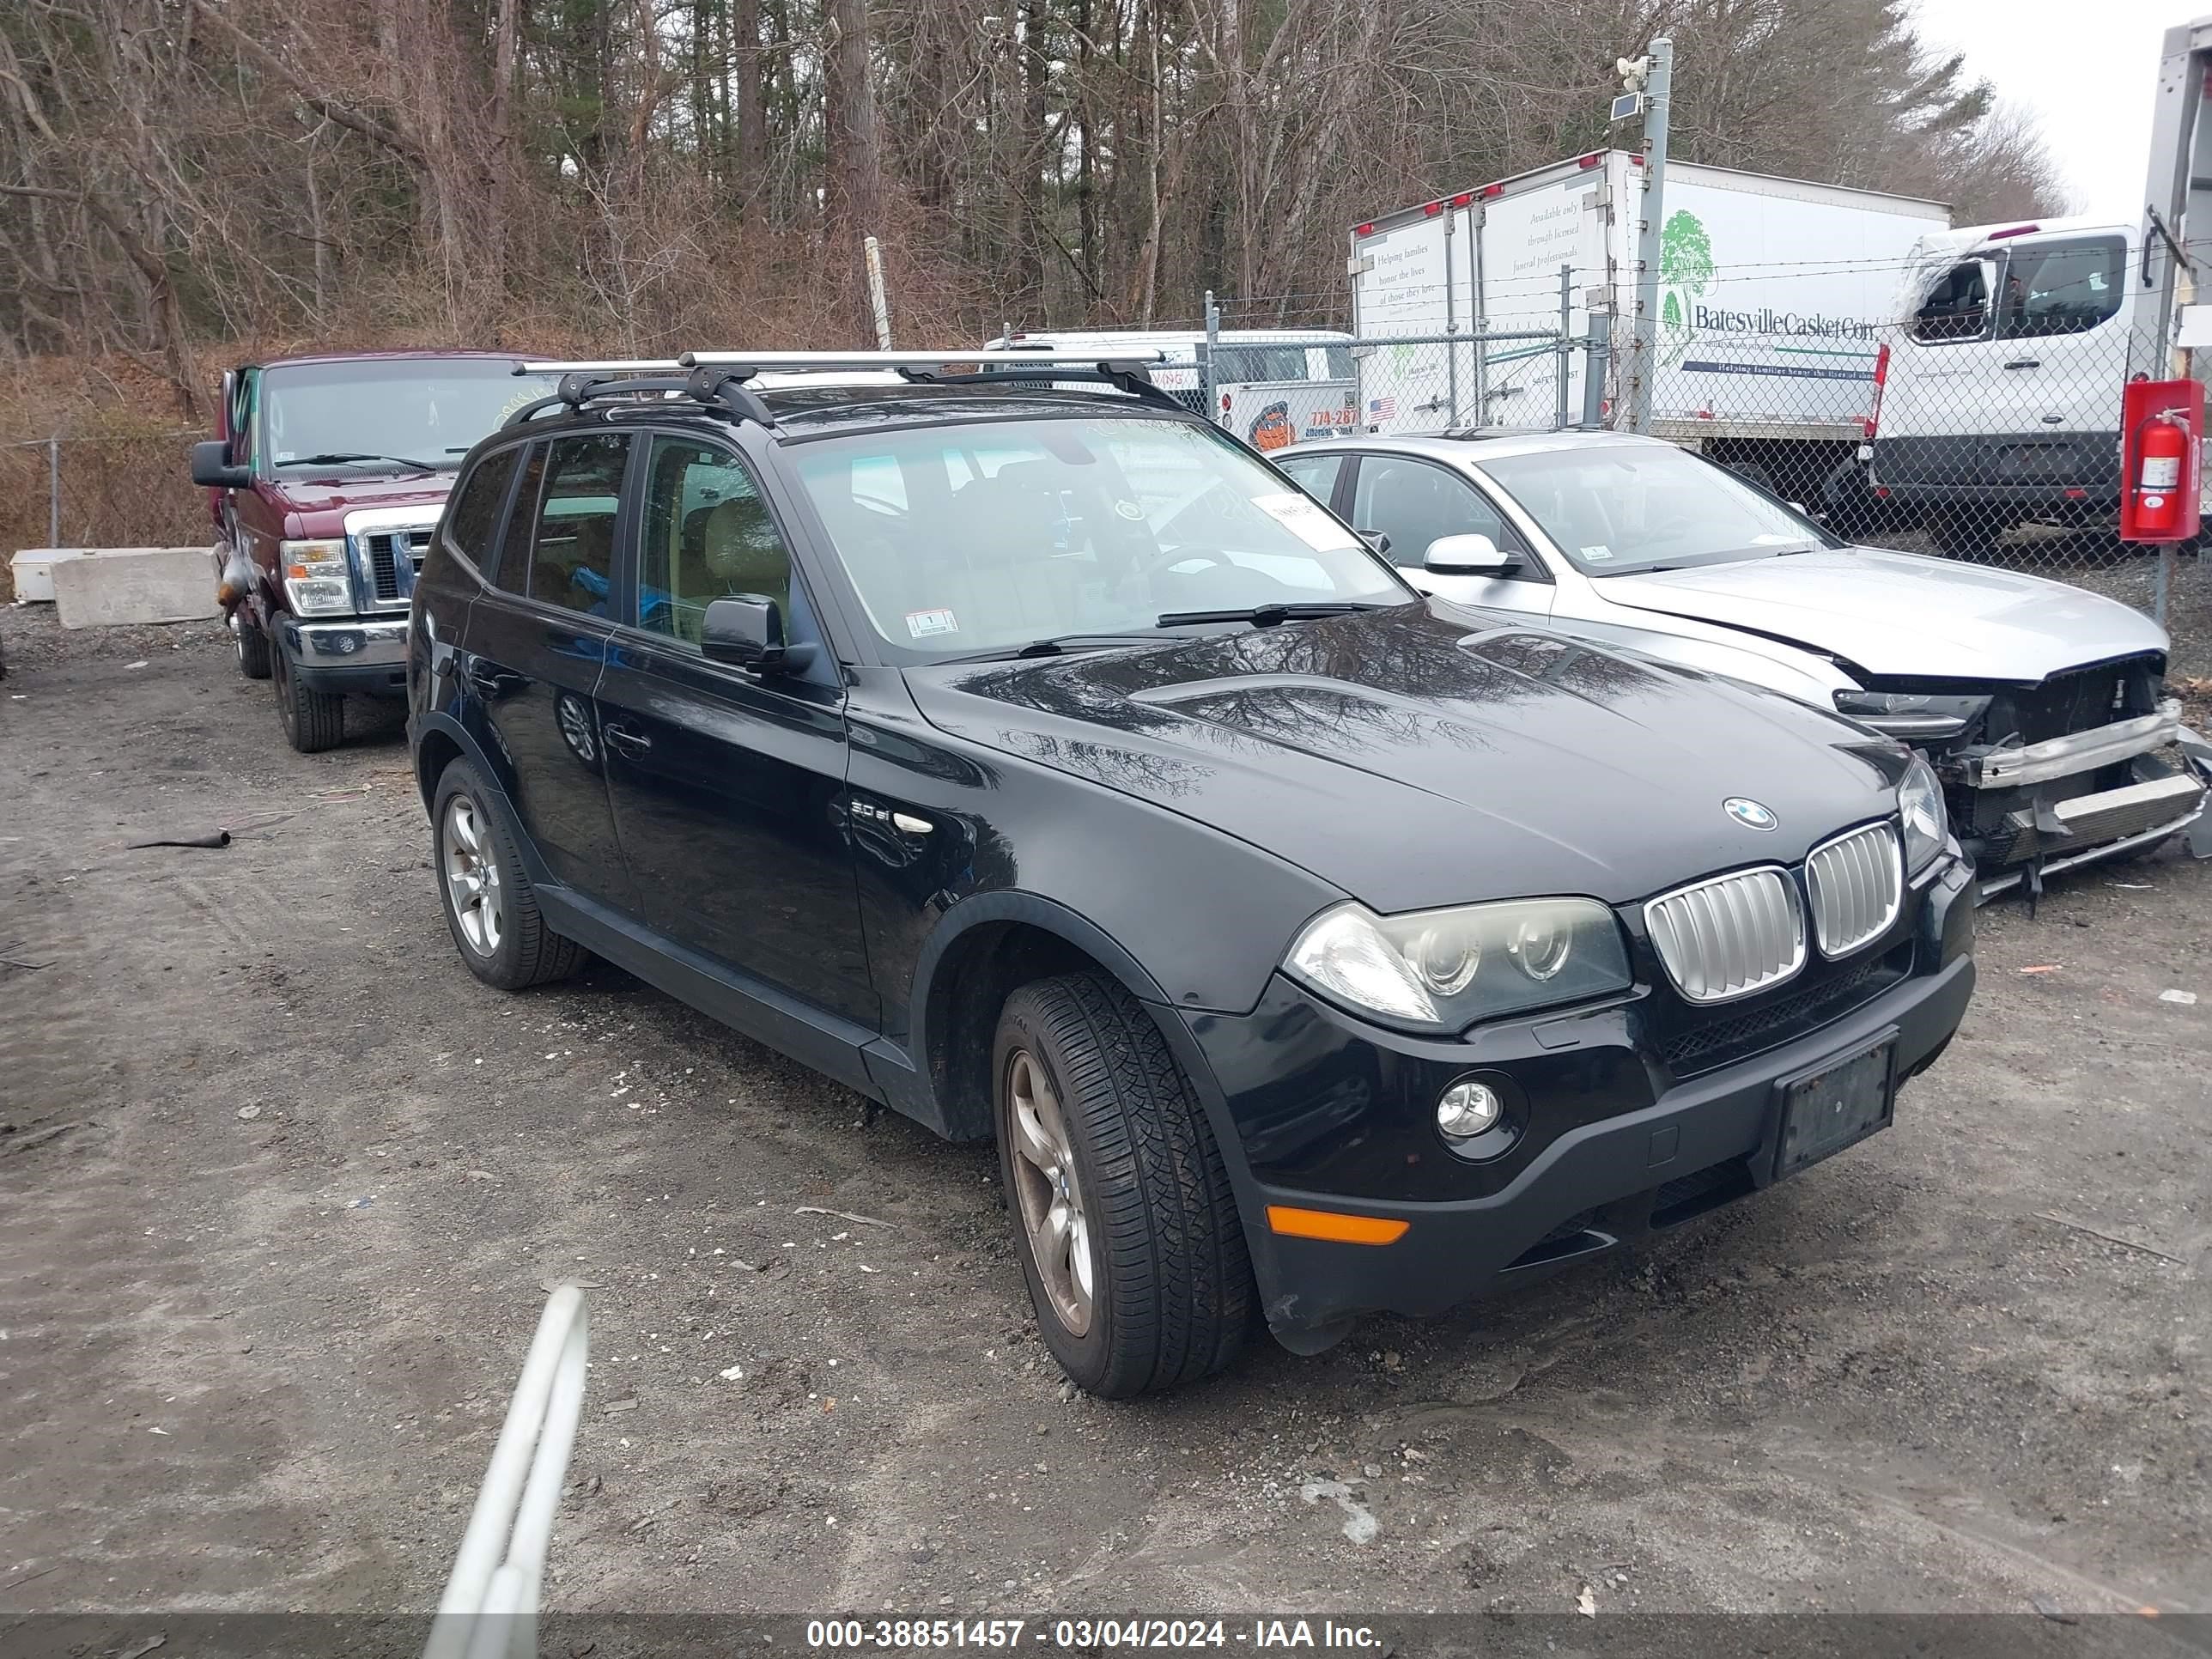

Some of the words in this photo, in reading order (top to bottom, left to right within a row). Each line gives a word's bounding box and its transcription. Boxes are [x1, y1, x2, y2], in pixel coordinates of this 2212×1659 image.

[1563, 201, 1578, 215] only
[1555, 222, 1579, 240] licensed
[1377, 252, 1403, 266] Helping
[1404, 244, 1428, 258] families
[1513, 255, 1535, 275] funeral
[1537, 245, 1577, 268] professionals
[1378, 273, 1397, 286] honor
[1399, 269, 1409, 281] the
[1411, 266, 1425, 277] lives
[1380, 293, 1388, 306] of
[1388, 291, 1405, 303] those
[1407, 287, 1420, 299] they
[1718, 363, 1752, 374] Helping
[1754, 365, 1786, 375] families
